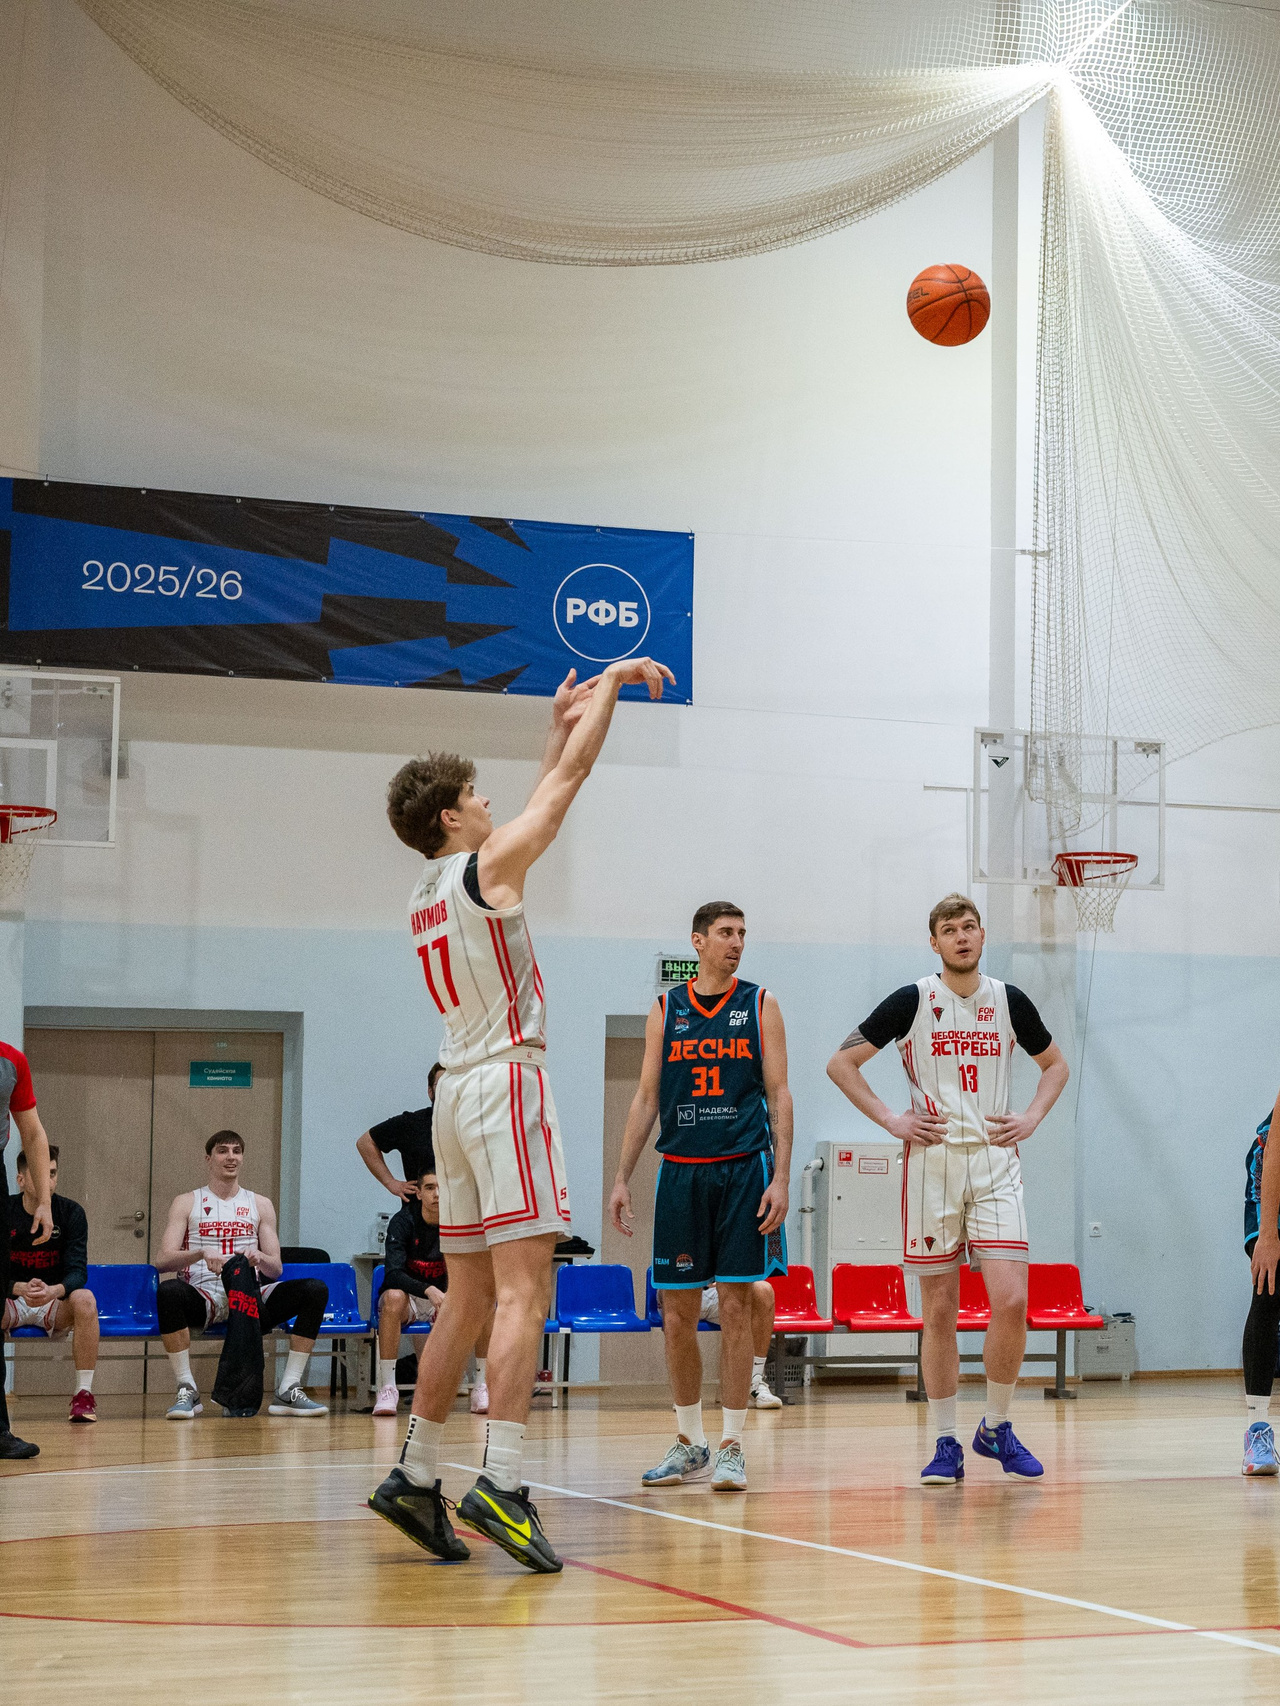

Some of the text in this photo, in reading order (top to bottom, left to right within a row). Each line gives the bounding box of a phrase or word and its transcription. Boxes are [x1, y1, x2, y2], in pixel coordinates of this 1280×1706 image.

[81, 560, 243, 600] 2025/26
[566, 597, 639, 628] РФБ
[729, 1010, 749, 1019] FON
[729, 1018, 749, 1026] BET
[977, 1014, 994, 1022] BET
[931, 1030, 1000, 1041] ЧЕБОКСАРСКИЕ
[667, 1038, 753, 1062] ДЕСНА
[931, 1040, 1001, 1057] ЯСТРЕБЫ
[691, 1066, 725, 1097] 31
[958, 1063, 978, 1093] 13
[699, 1106, 738, 1114] НАДЕЖДА
[220, 1238, 234, 1255] 11
[655, 1257, 670, 1265] TEAM
